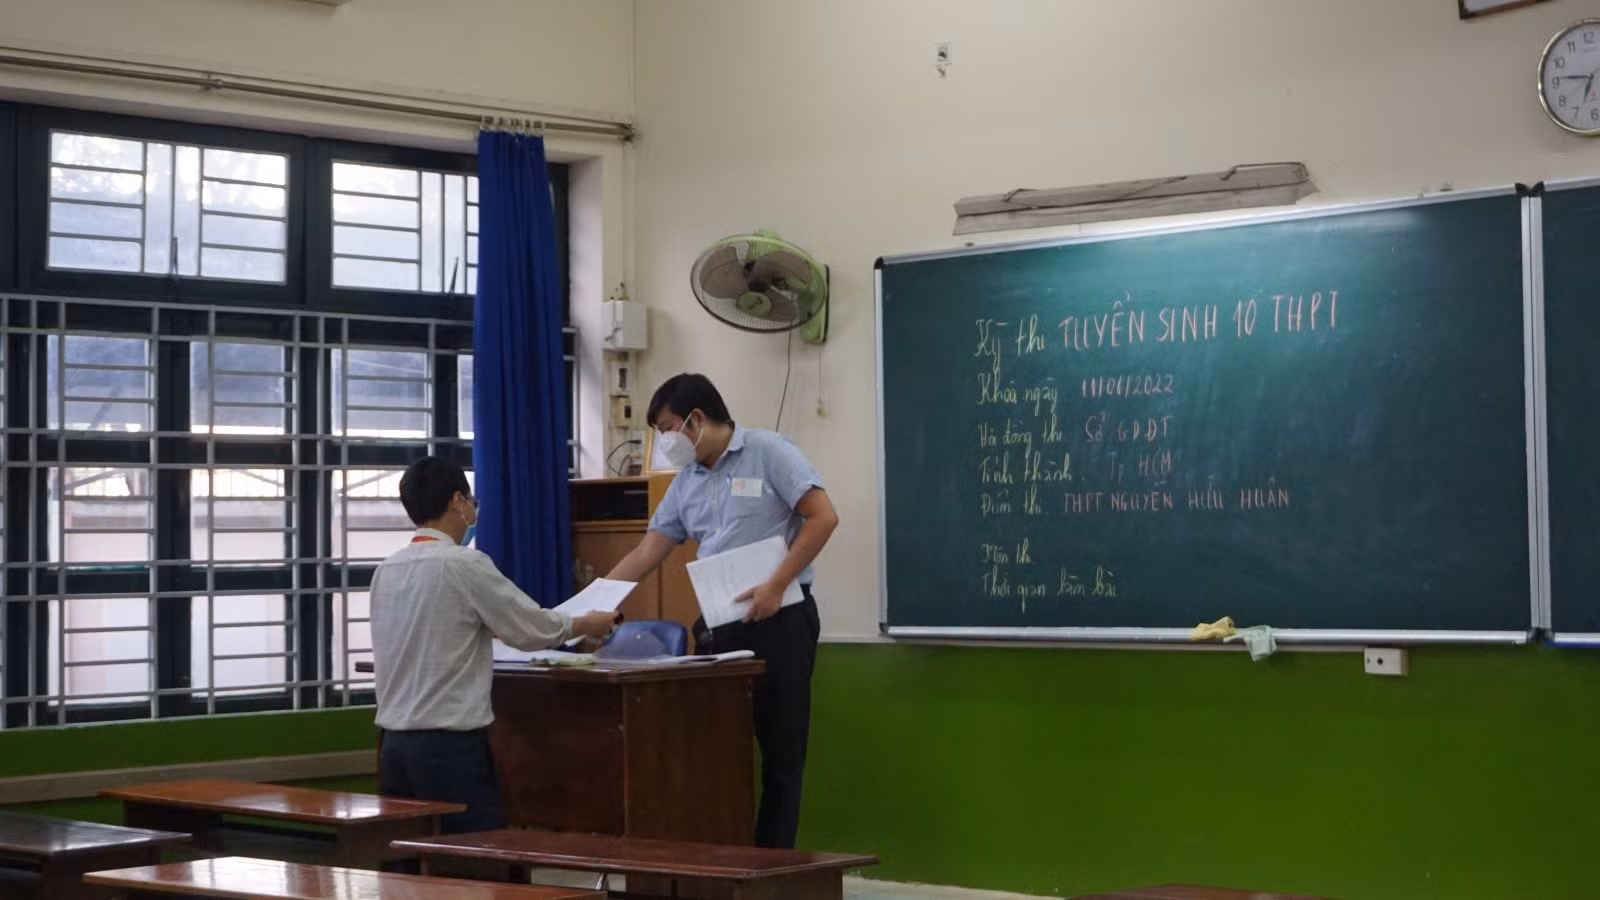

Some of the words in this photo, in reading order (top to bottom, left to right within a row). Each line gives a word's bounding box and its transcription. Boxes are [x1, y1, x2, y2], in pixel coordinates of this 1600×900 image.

[1583, 31, 1595, 45] 12
[1567, 41, 1576, 53] 11
[1555, 56, 1566, 70] 10
[1552, 76, 1560, 89] 9
[1558, 95, 1567, 107] 8
[1572, 106, 1580, 119] 7
[1590, 108, 1599, 121] 6
[1015, 313, 1045, 357] thi
[1058, 290, 1144, 351] TUYỂN
[1156, 304, 1217, 343] SINH
[1232, 298, 1257, 338] 10
[1272, 290, 1338, 333] THPT
[1025, 377, 1058, 416] ngày
[1042, 413, 1062, 443] thi
[1085, 411, 1106, 443] Sở
[980, 451, 1013, 484] Tỉnh
[1137, 450, 1173, 476] HCM
[1064, 492, 1104, 513] THPT
[1111, 480, 1173, 512] NGUYỄN
[1240, 475, 1289, 510] HUÂN
[1018, 583, 1046, 614] gian
[1057, 566, 1086, 598] làm
[1092, 565, 1117, 597] bài
